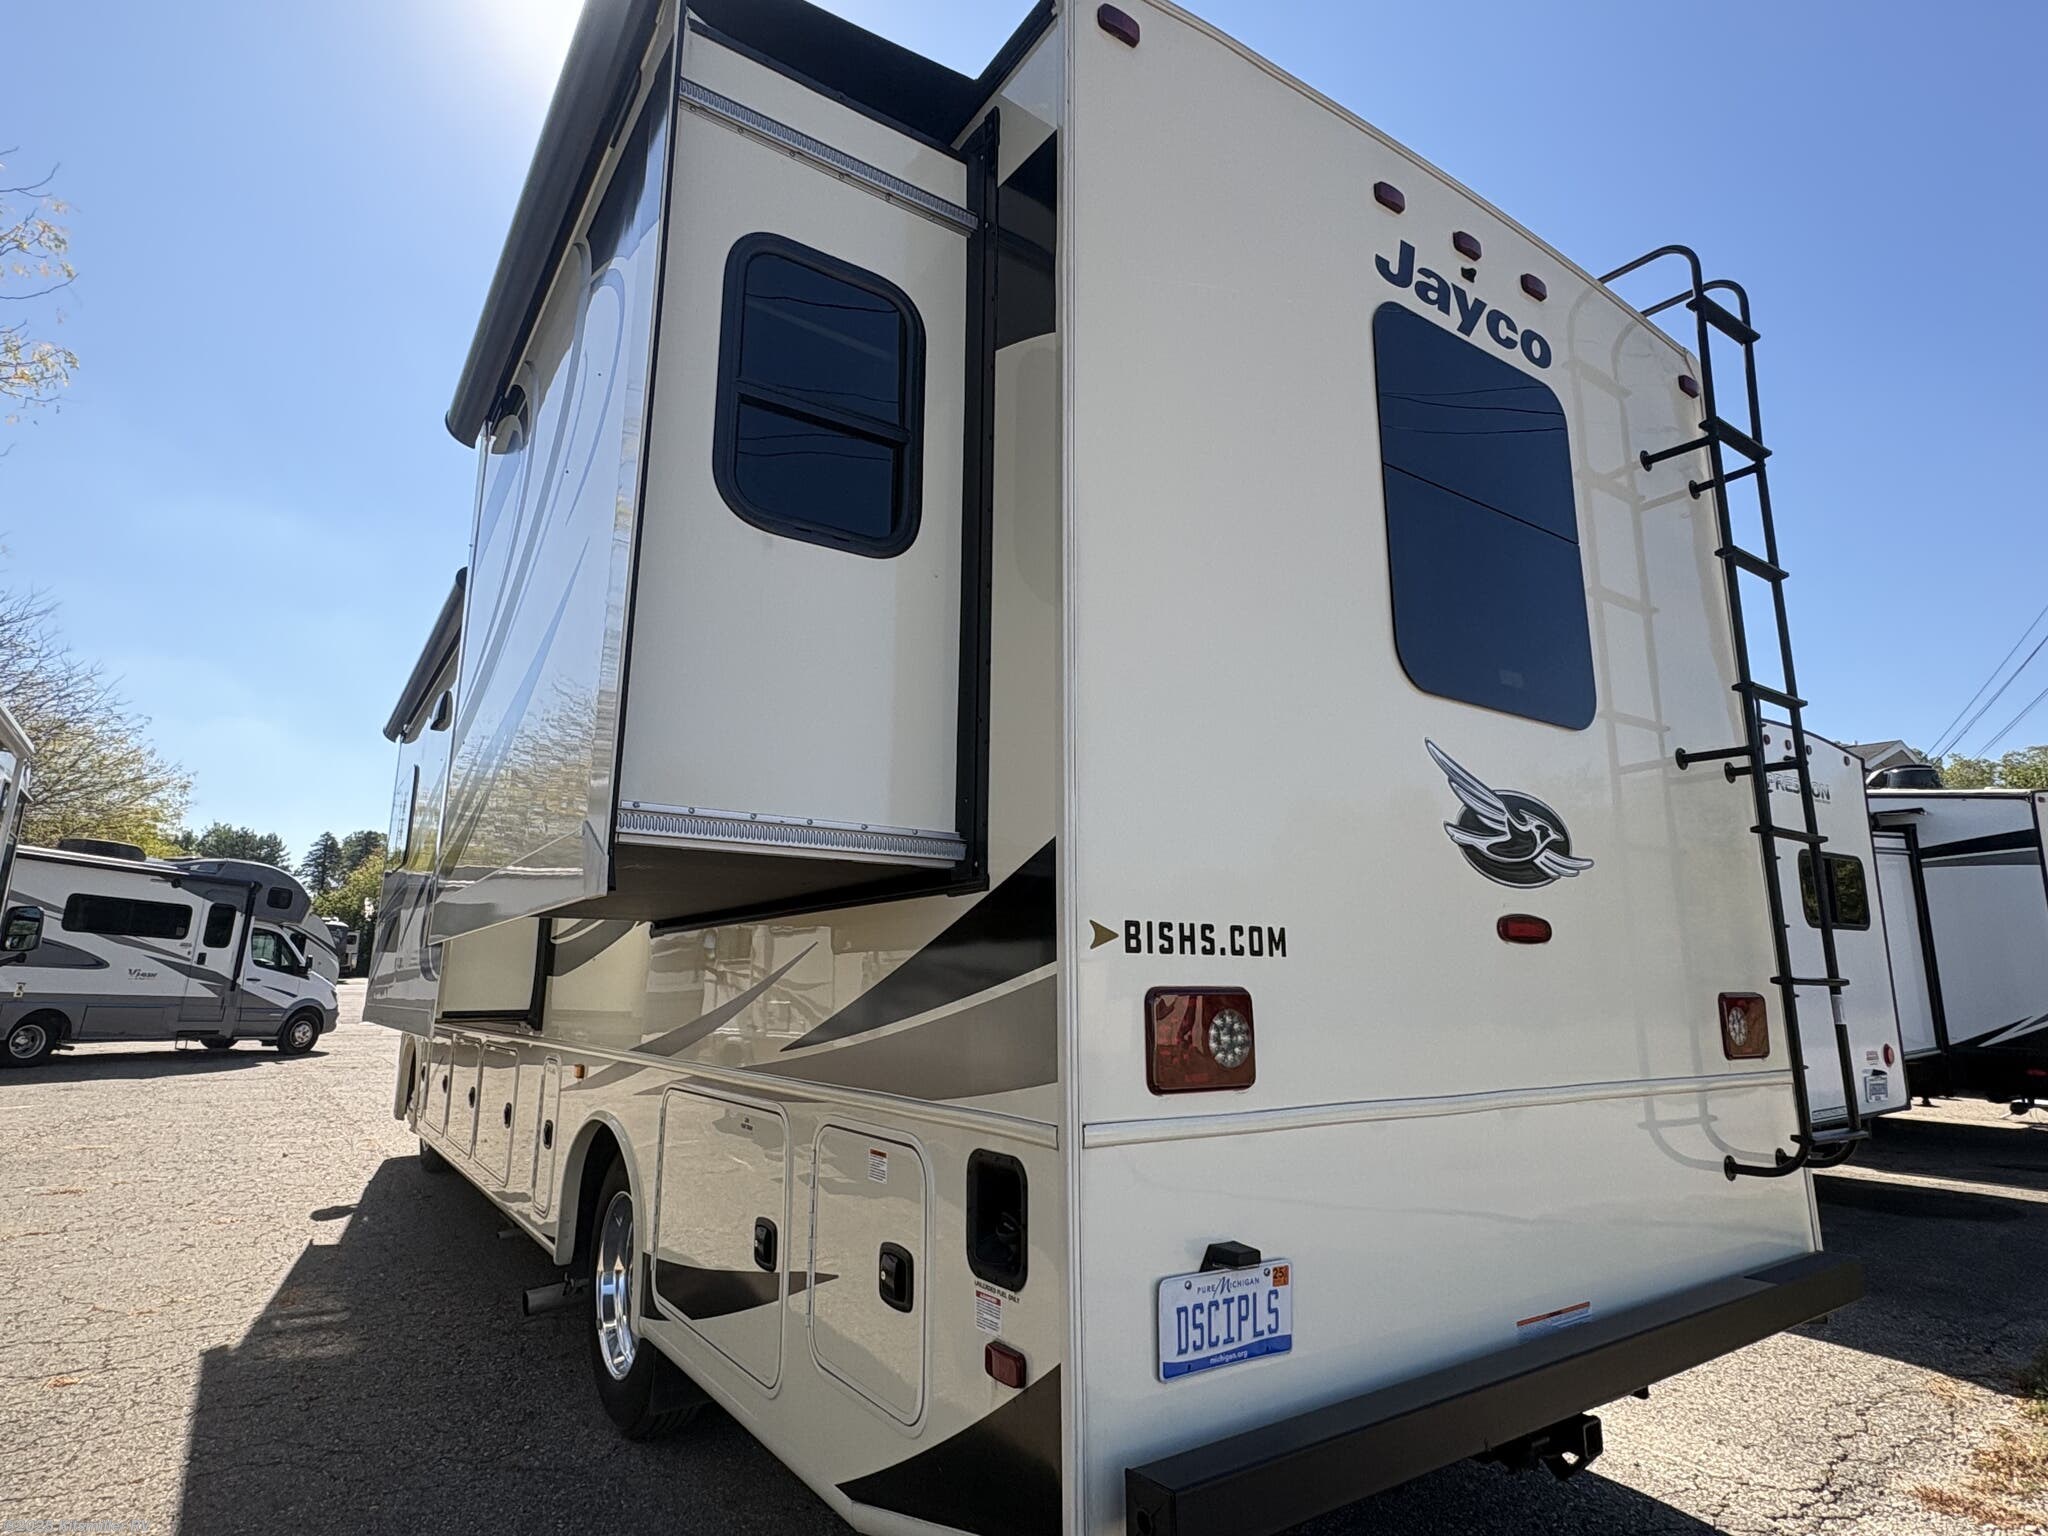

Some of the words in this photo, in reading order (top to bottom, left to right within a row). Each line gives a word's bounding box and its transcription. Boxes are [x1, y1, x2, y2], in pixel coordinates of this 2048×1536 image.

[1375, 239, 1552, 369] Jayco
[1124, 919, 1287, 957] BISHS.COM
[1197, 1283, 1216, 1294] PURE
[1176, 1289, 1279, 1356] DSCIPLS
[1210, 1350, 1248, 1365] michigan.org
